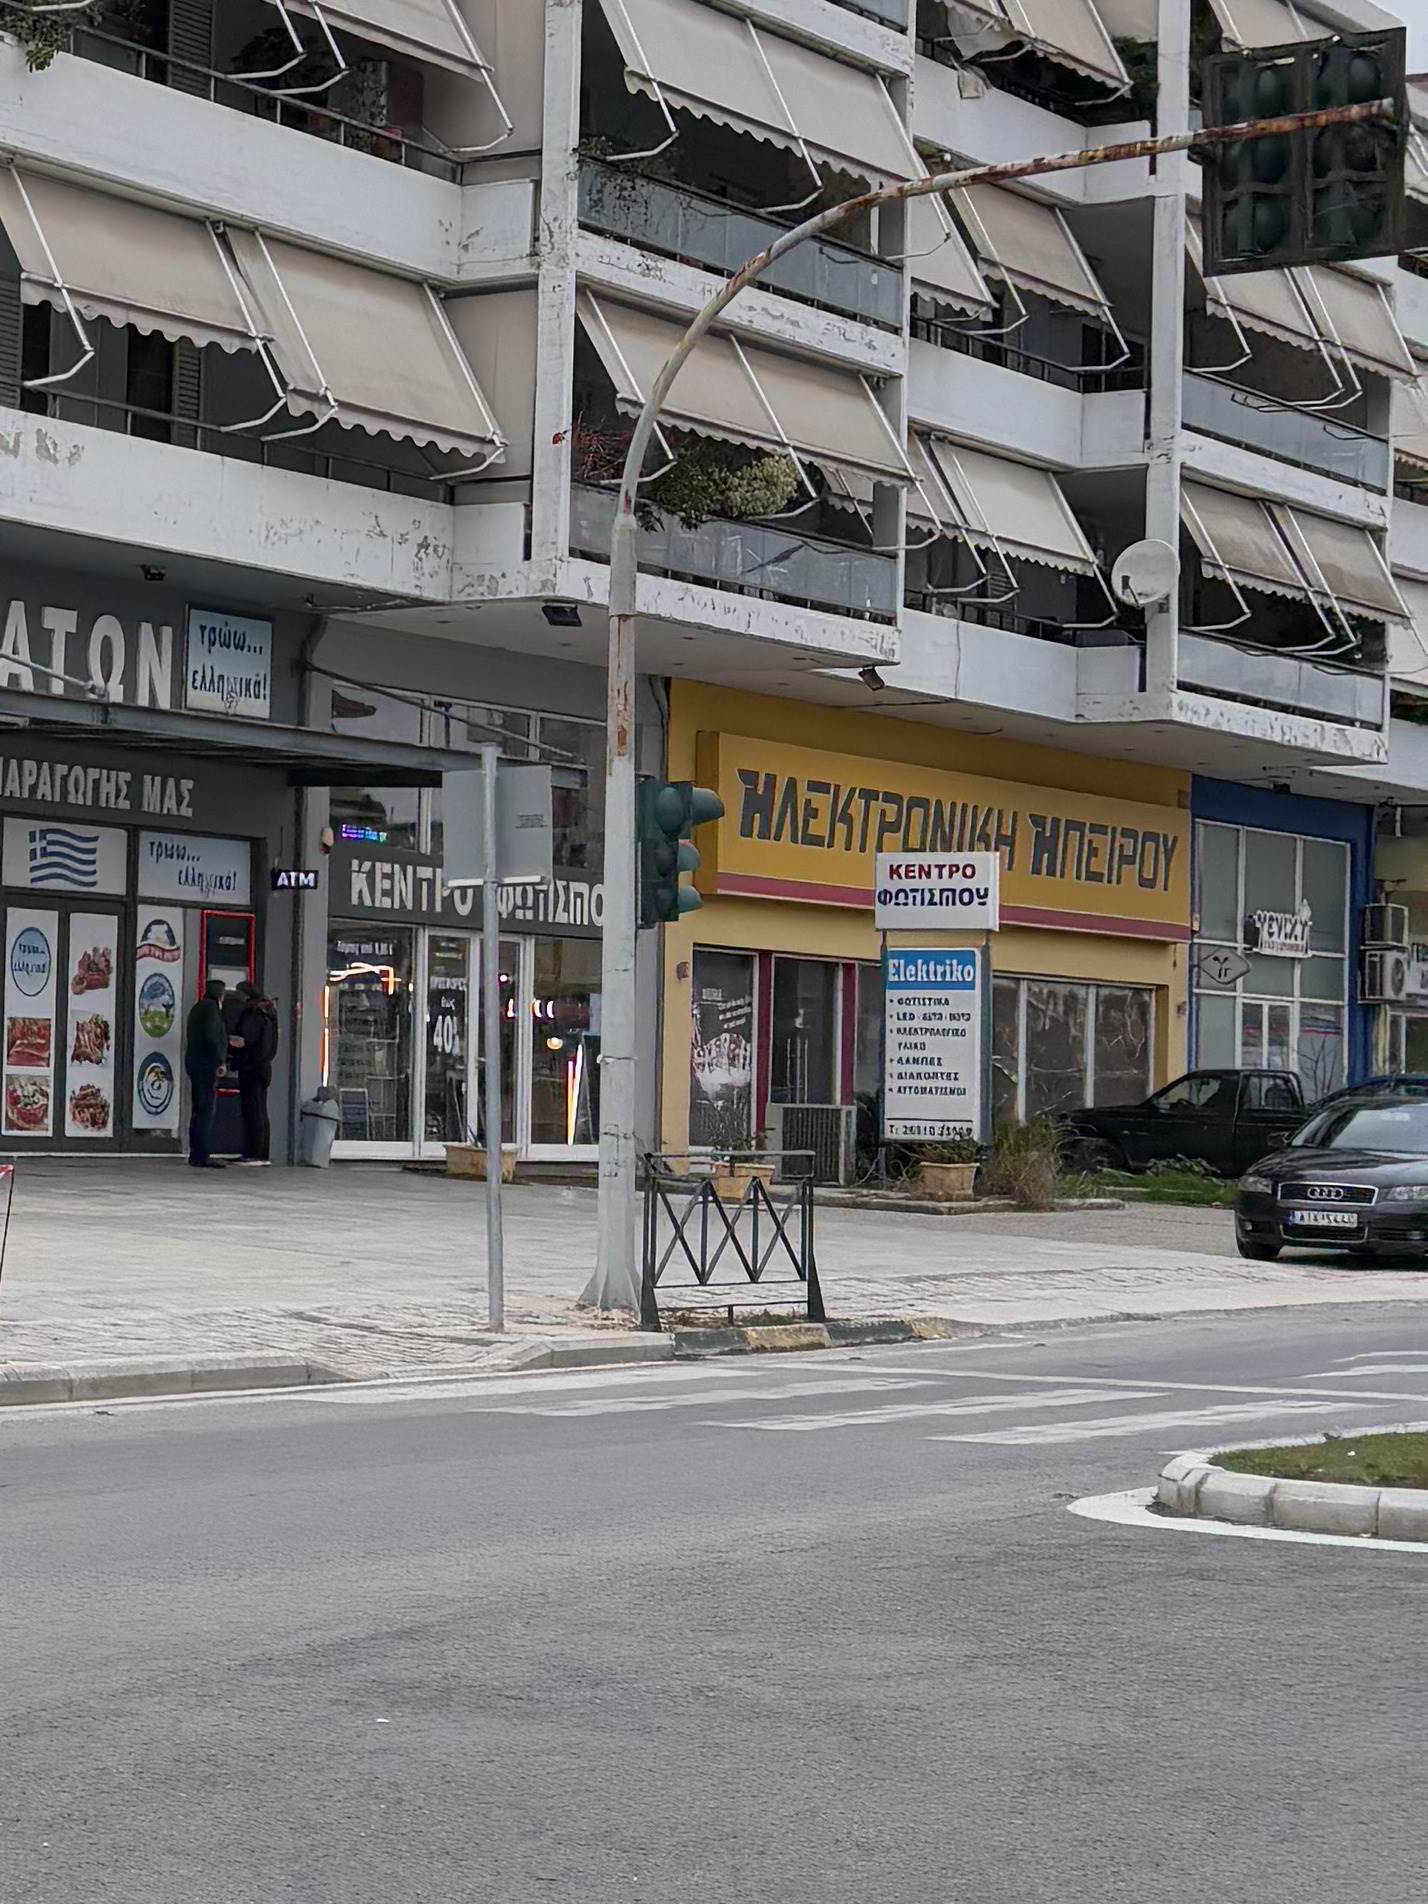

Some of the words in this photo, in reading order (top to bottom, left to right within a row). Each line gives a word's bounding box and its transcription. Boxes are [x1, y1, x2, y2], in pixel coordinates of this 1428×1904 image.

[142, 774, 194, 817] ΜΑΣ
[737, 768, 1019, 871] ΗΛΕΚΤΡΟΝΙΚΗ
[1029, 812, 1178, 892] ΗΠΕΙΡΟΥ
[276, 872, 315, 887] ATM
[889, 863, 976, 880] ΚΕΝΤΡΟ
[497, 879, 604, 927] ΦΩΤΙΣΜΟ
[877, 887, 989, 907] ΦΩΤΙΣΜΟΥ
[888, 959, 974, 982] Elektriko
[896, 1012, 915, 1021] LED
